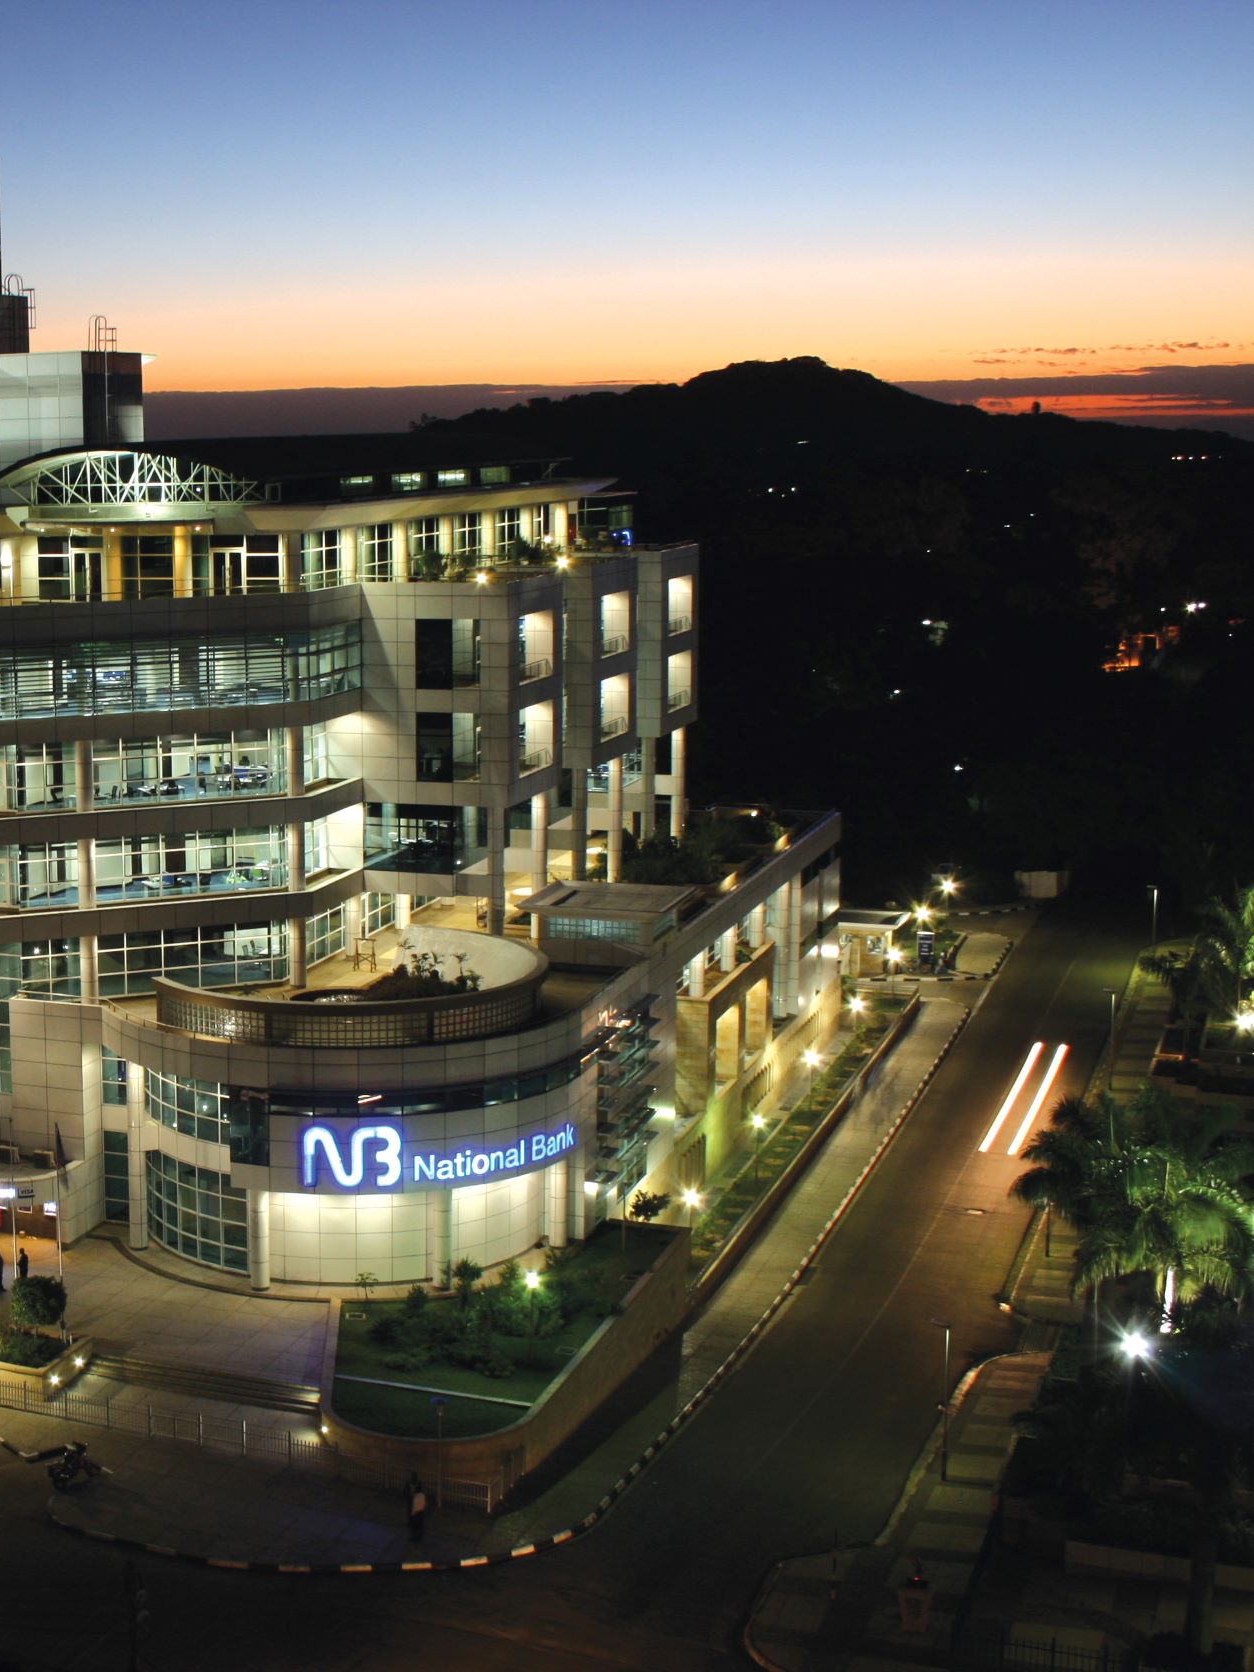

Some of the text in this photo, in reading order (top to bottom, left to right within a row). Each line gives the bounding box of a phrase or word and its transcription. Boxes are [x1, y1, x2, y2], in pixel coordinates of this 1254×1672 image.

[302, 1122, 575, 1188] NB National Bank
